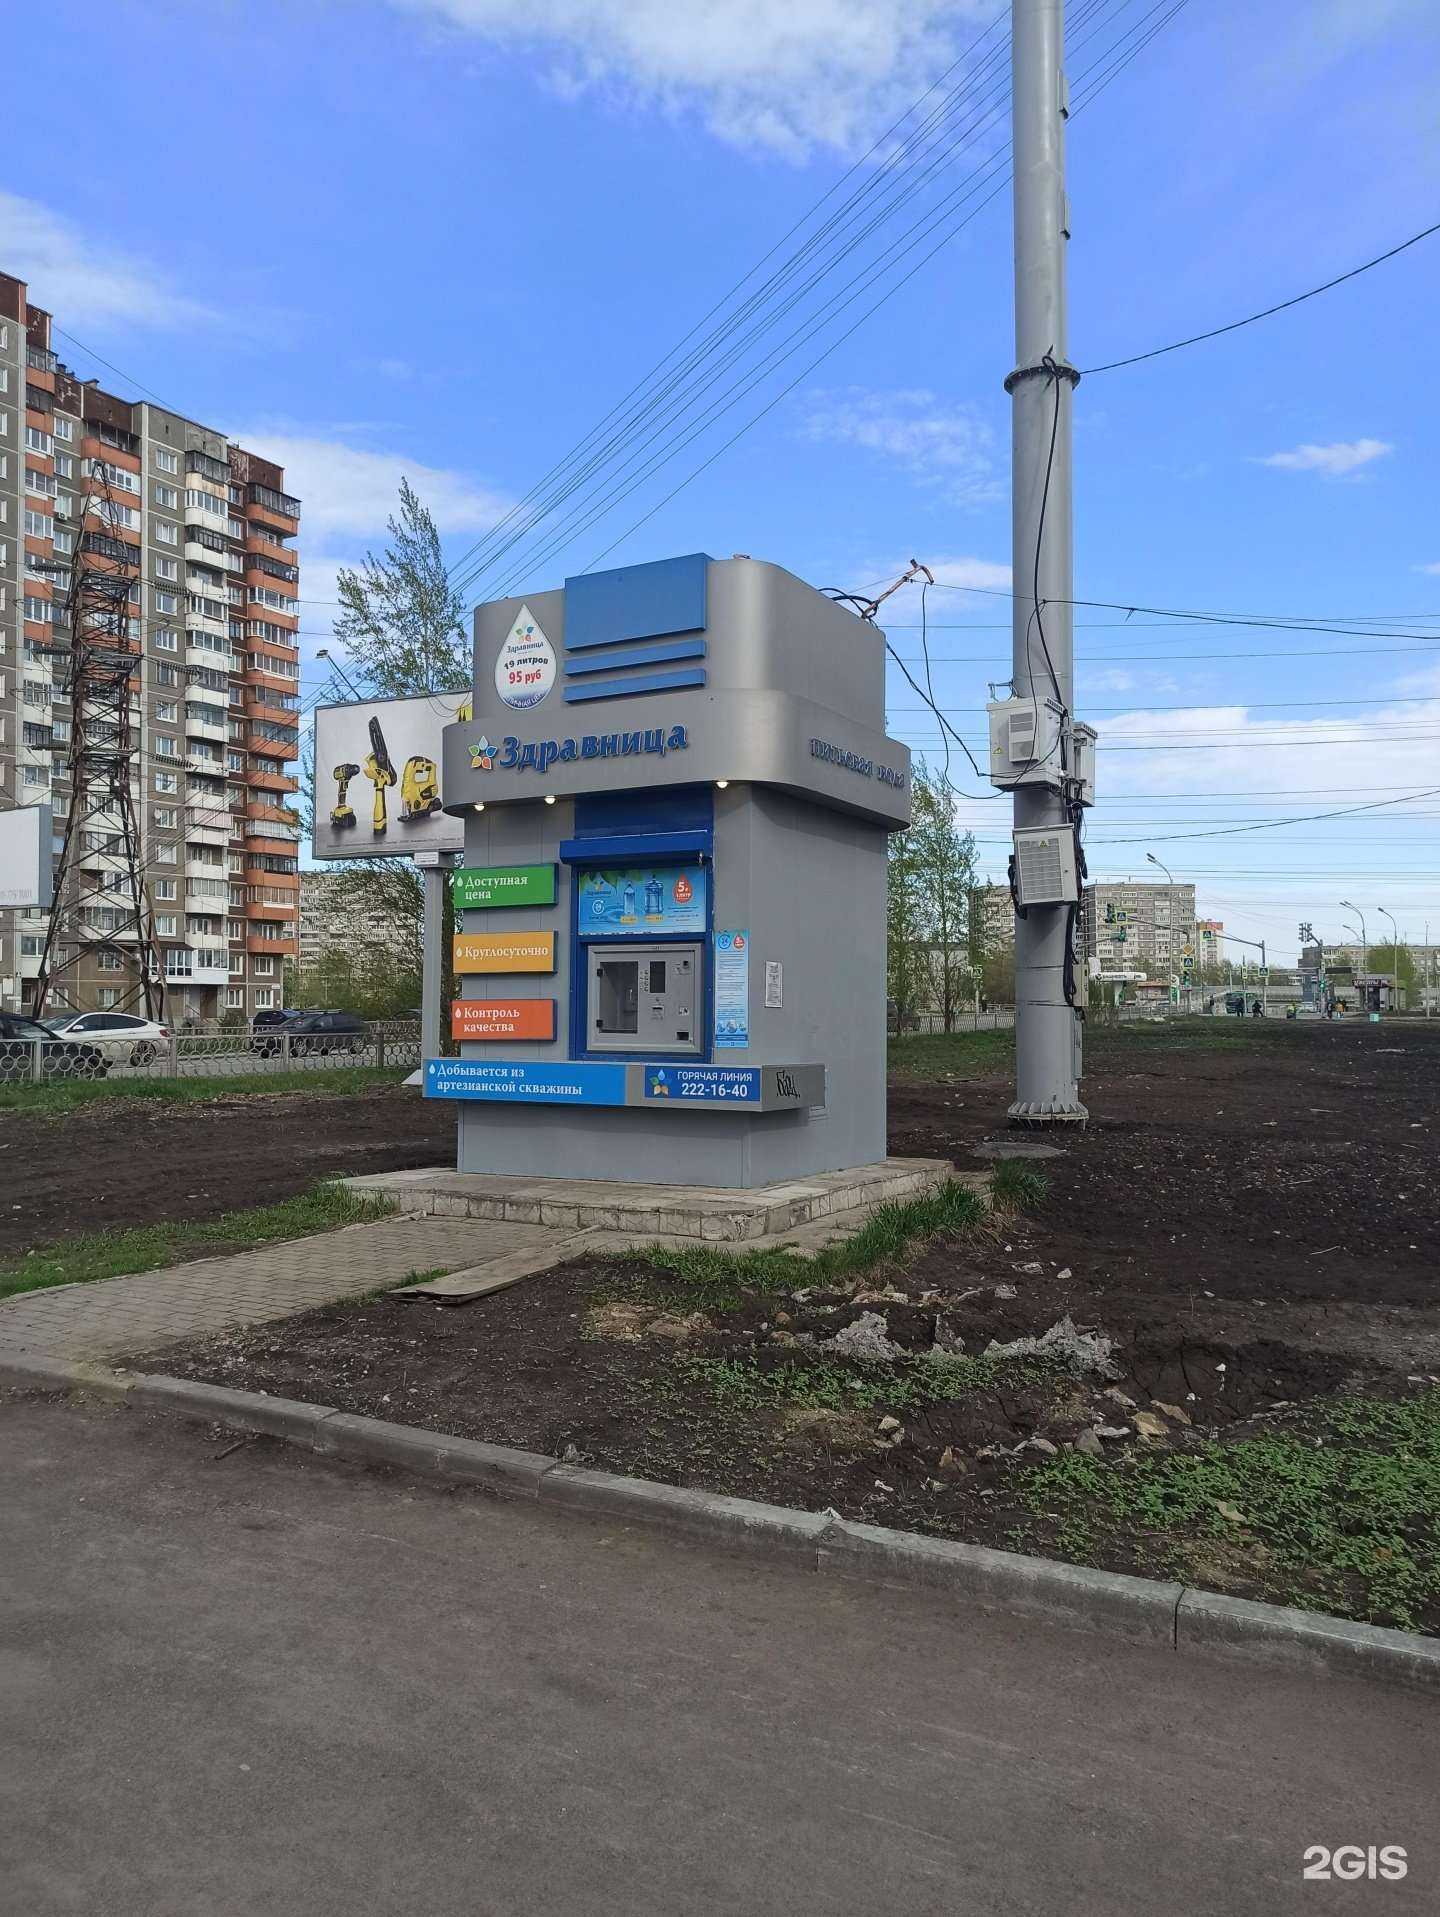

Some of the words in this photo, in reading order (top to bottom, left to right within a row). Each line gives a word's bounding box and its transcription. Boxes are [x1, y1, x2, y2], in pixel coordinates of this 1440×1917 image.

[504, 659, 515, 669] 19
[517, 656, 549, 667] литров
[509, 671, 523, 684] 95
[525, 669, 542, 684] руб
[500, 724, 689, 774] Здравница
[465, 875, 528, 889] Доступная
[465, 889, 492, 901] цена
[465, 945, 549, 960] Круглосуточно
[464, 1007, 520, 1020] Контроль
[464, 1021, 514, 1032] качества
[437, 1063, 508, 1077] Добывается
[511, 1068, 525, 1077] из
[677, 1071, 718, 1081] ГОРЯЧАЯ
[720, 1072, 753, 1082] ЛИНИЯ
[437, 1081, 516, 1093] артезианской
[518, 1083, 583, 1095] скважины
[681, 1082, 748, 1097] 222-16-40
